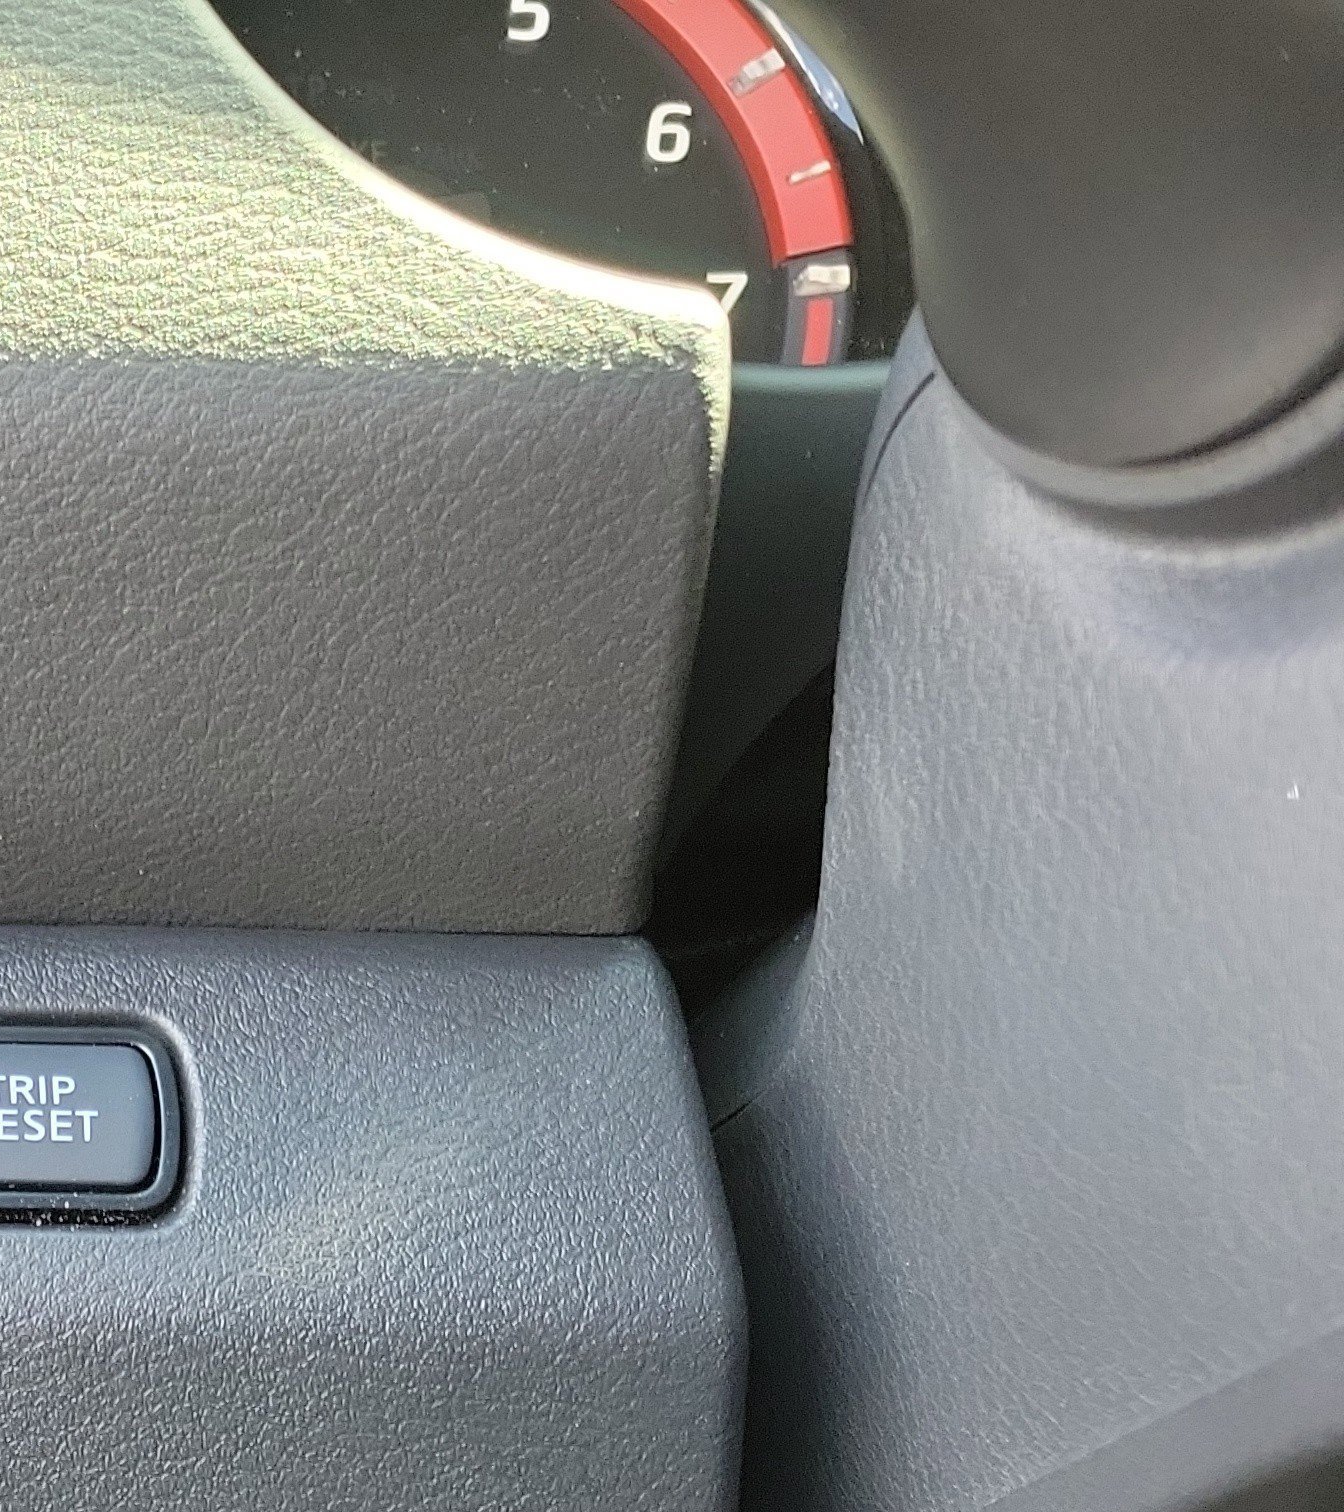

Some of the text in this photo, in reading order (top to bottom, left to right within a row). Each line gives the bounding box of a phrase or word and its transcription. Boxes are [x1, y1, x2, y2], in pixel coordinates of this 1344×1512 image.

[507, 0, 550, 41] 5
[645, 101, 692, 163] 6
[706, 271, 749, 314] 7
